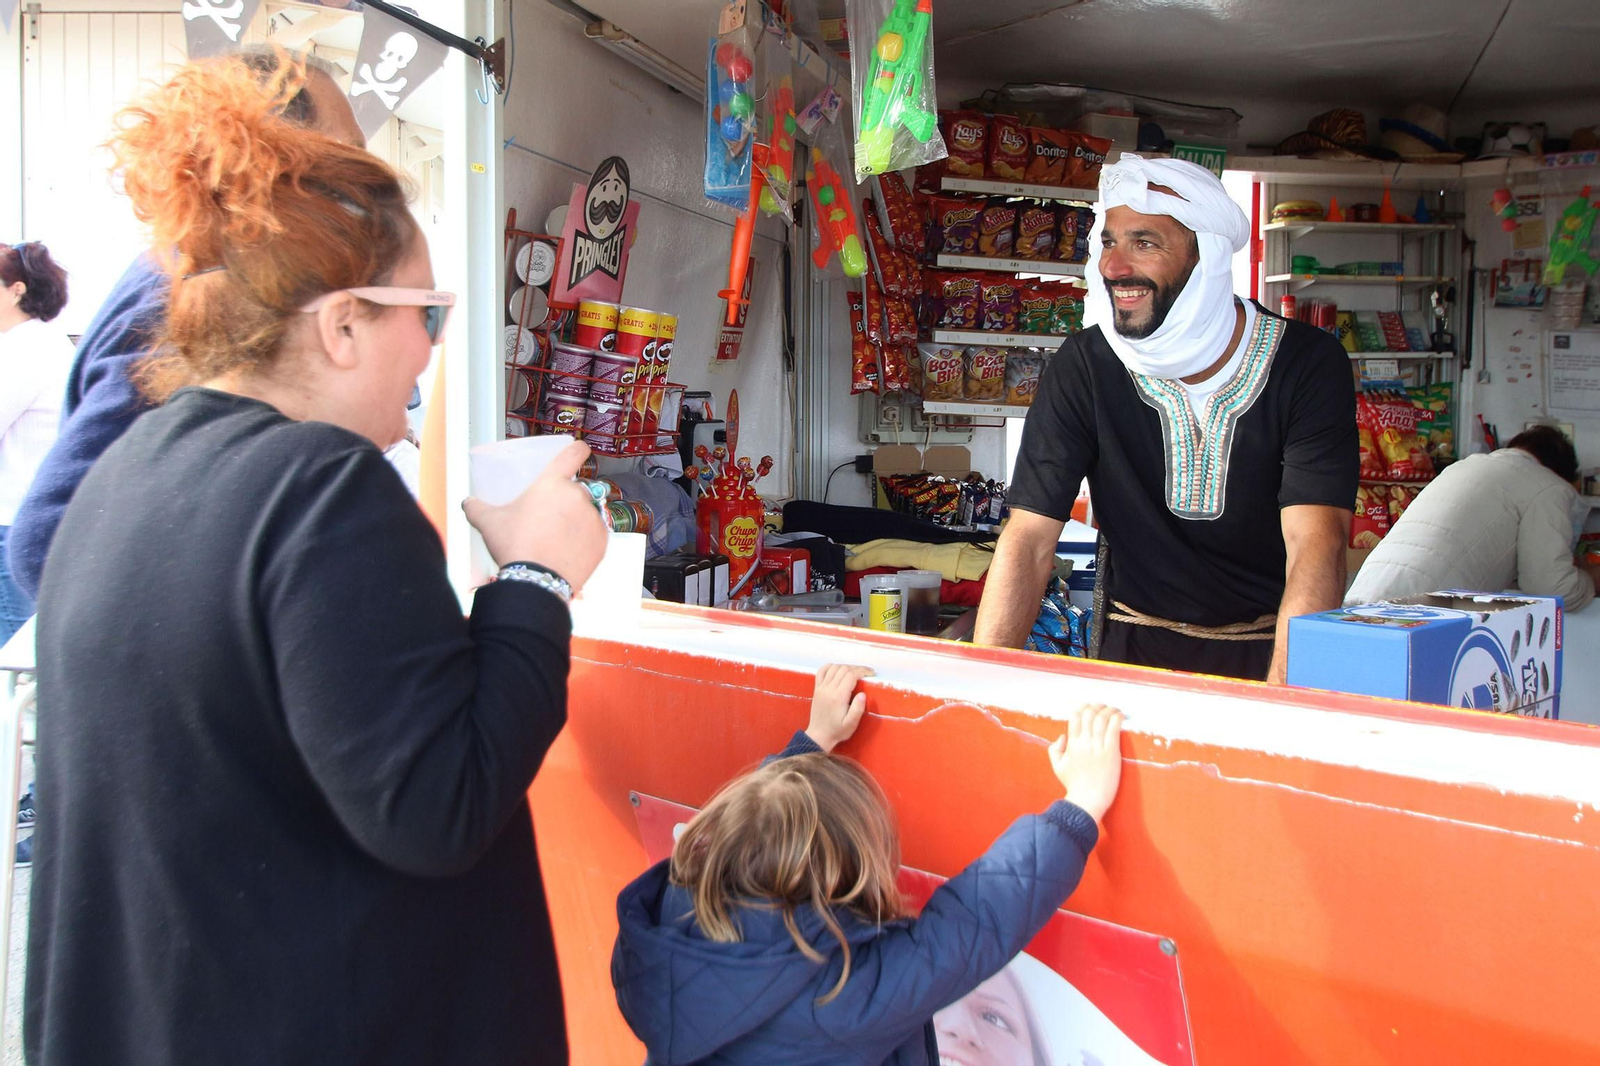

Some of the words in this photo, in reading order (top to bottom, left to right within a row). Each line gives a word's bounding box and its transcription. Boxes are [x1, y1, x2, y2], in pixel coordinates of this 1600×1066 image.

[570, 231, 626, 285] PRINGLES
[581, 310, 601, 320] GRATIS
[623, 317, 645, 328] GRATIS
[720, 333, 742, 344] EXTINTOR
[936, 368, 961, 384] Bits
[981, 366, 1005, 380] Bits
[730, 525, 757, 537] Chupa
[728, 535, 757, 552] Chups
